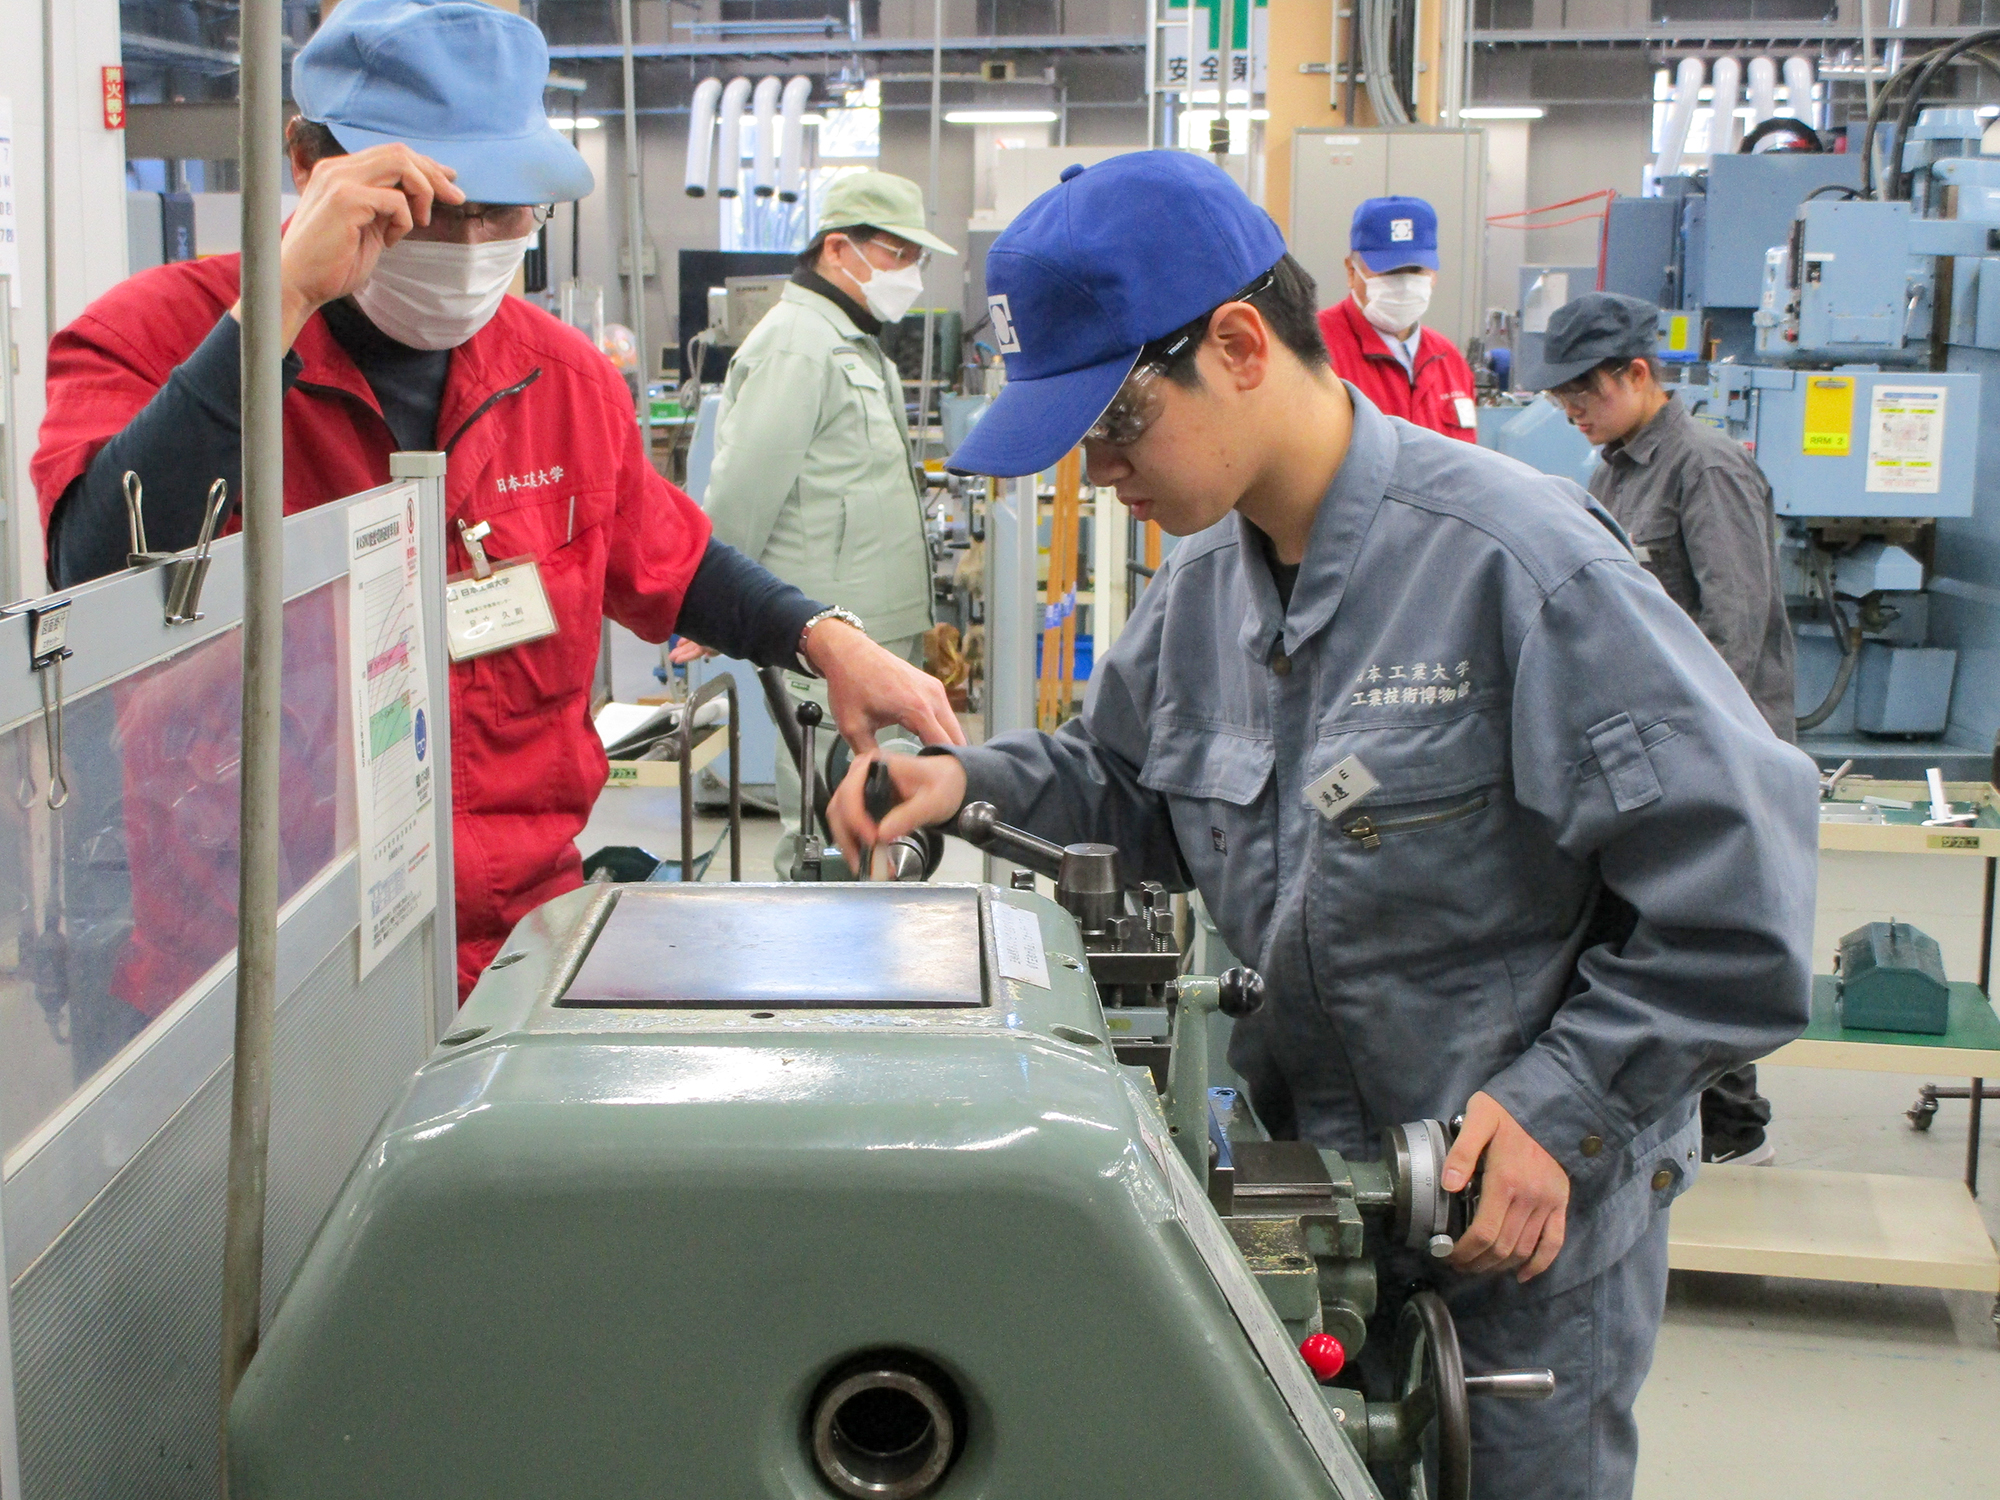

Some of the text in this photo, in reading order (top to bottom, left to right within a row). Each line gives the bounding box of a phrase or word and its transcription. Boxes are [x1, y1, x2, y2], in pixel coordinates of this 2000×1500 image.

[1168, 56, 1267, 82] 安全第
[1809, 436, 1844, 446] RRM 2
[1338, 769, 1350, 780] E
